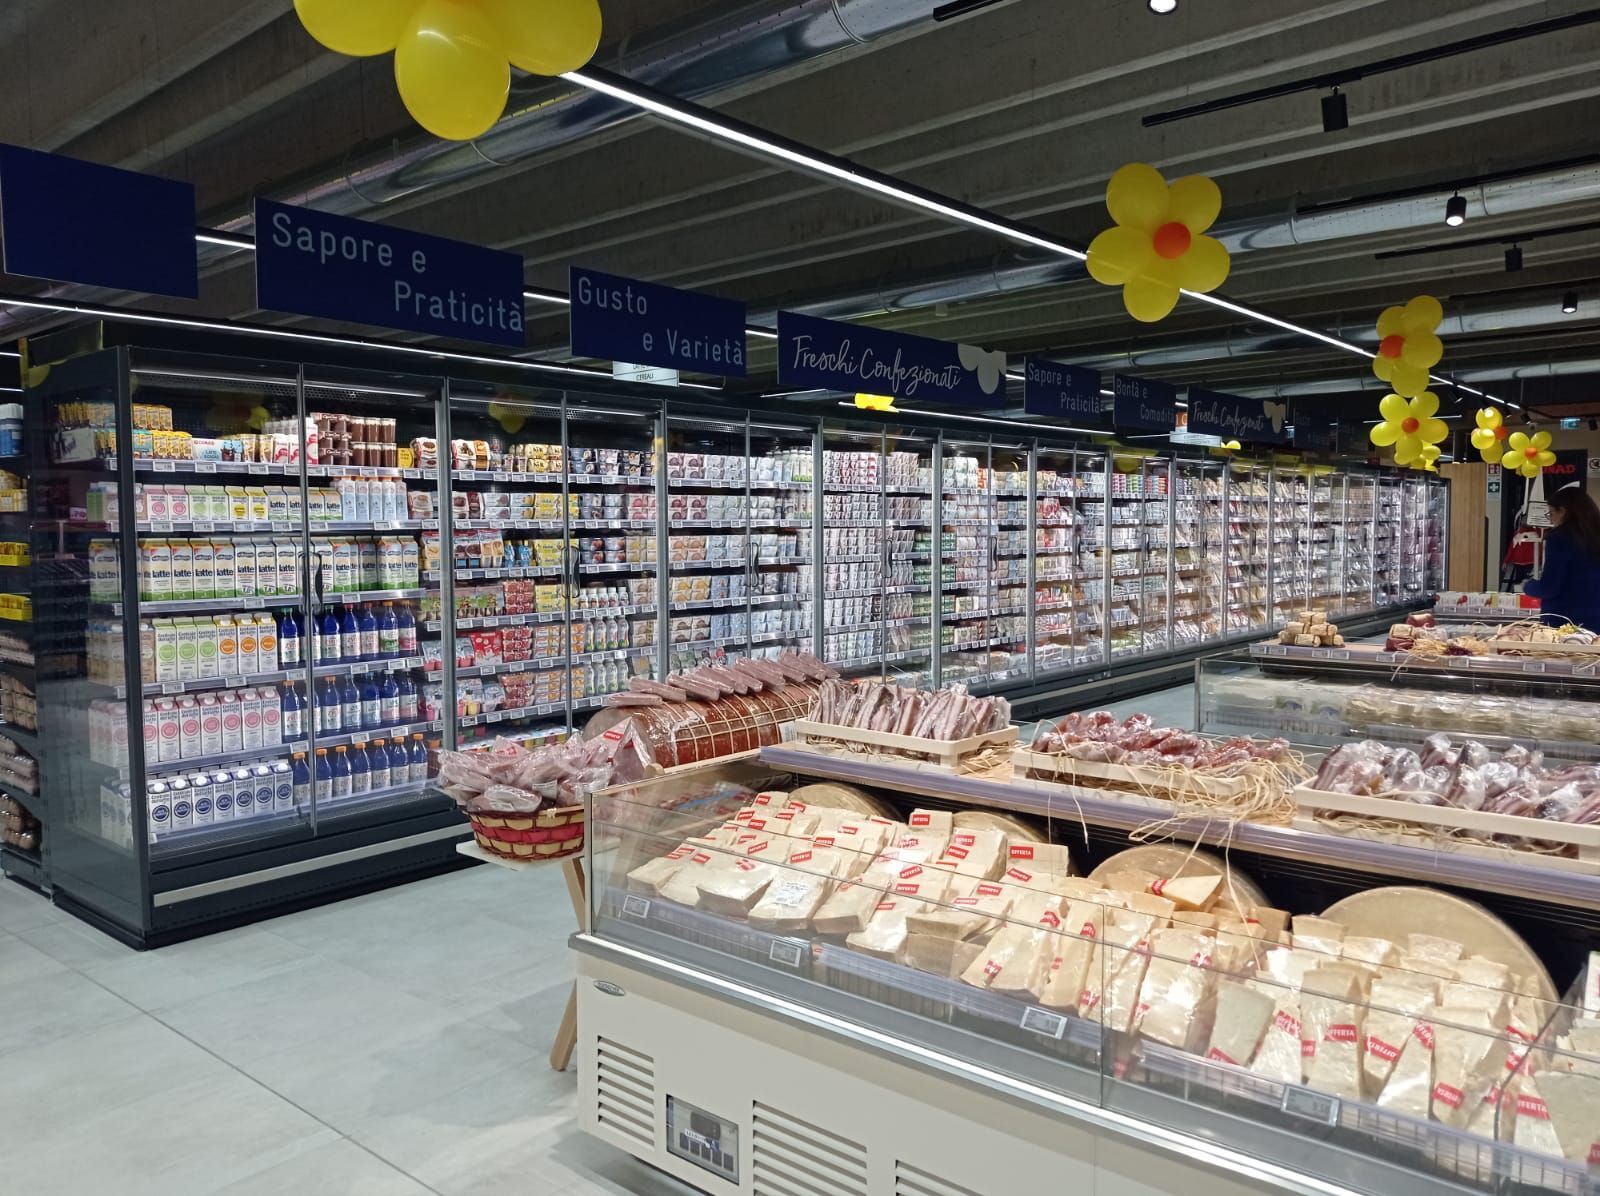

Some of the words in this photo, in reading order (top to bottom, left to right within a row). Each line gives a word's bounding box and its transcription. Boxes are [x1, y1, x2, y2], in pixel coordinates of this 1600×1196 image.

[273, 213, 393, 266] Sapore
[411, 249, 427, 273] e
[394, 280, 524, 331] Praticità
[578, 277, 648, 315] Gusto
[642, 332, 653, 351] e
[666, 328, 744, 366] Varietà
[792, 335, 858, 375] Freschi
[859, 347, 962, 396] Confezionati
[1028, 362, 1062, 385] Sapore
[1066, 374, 1072, 386] e
[1116, 378, 1140, 398] Bontà
[1143, 389, 1148, 399] e
[1060, 391, 1101, 414] Praticità
[289, 501, 301, 509] latt
[152, 570, 171, 578] latte
[174, 569, 192, 578] latte
[195, 569, 213, 577] latte
[216, 568, 234, 577] latte
